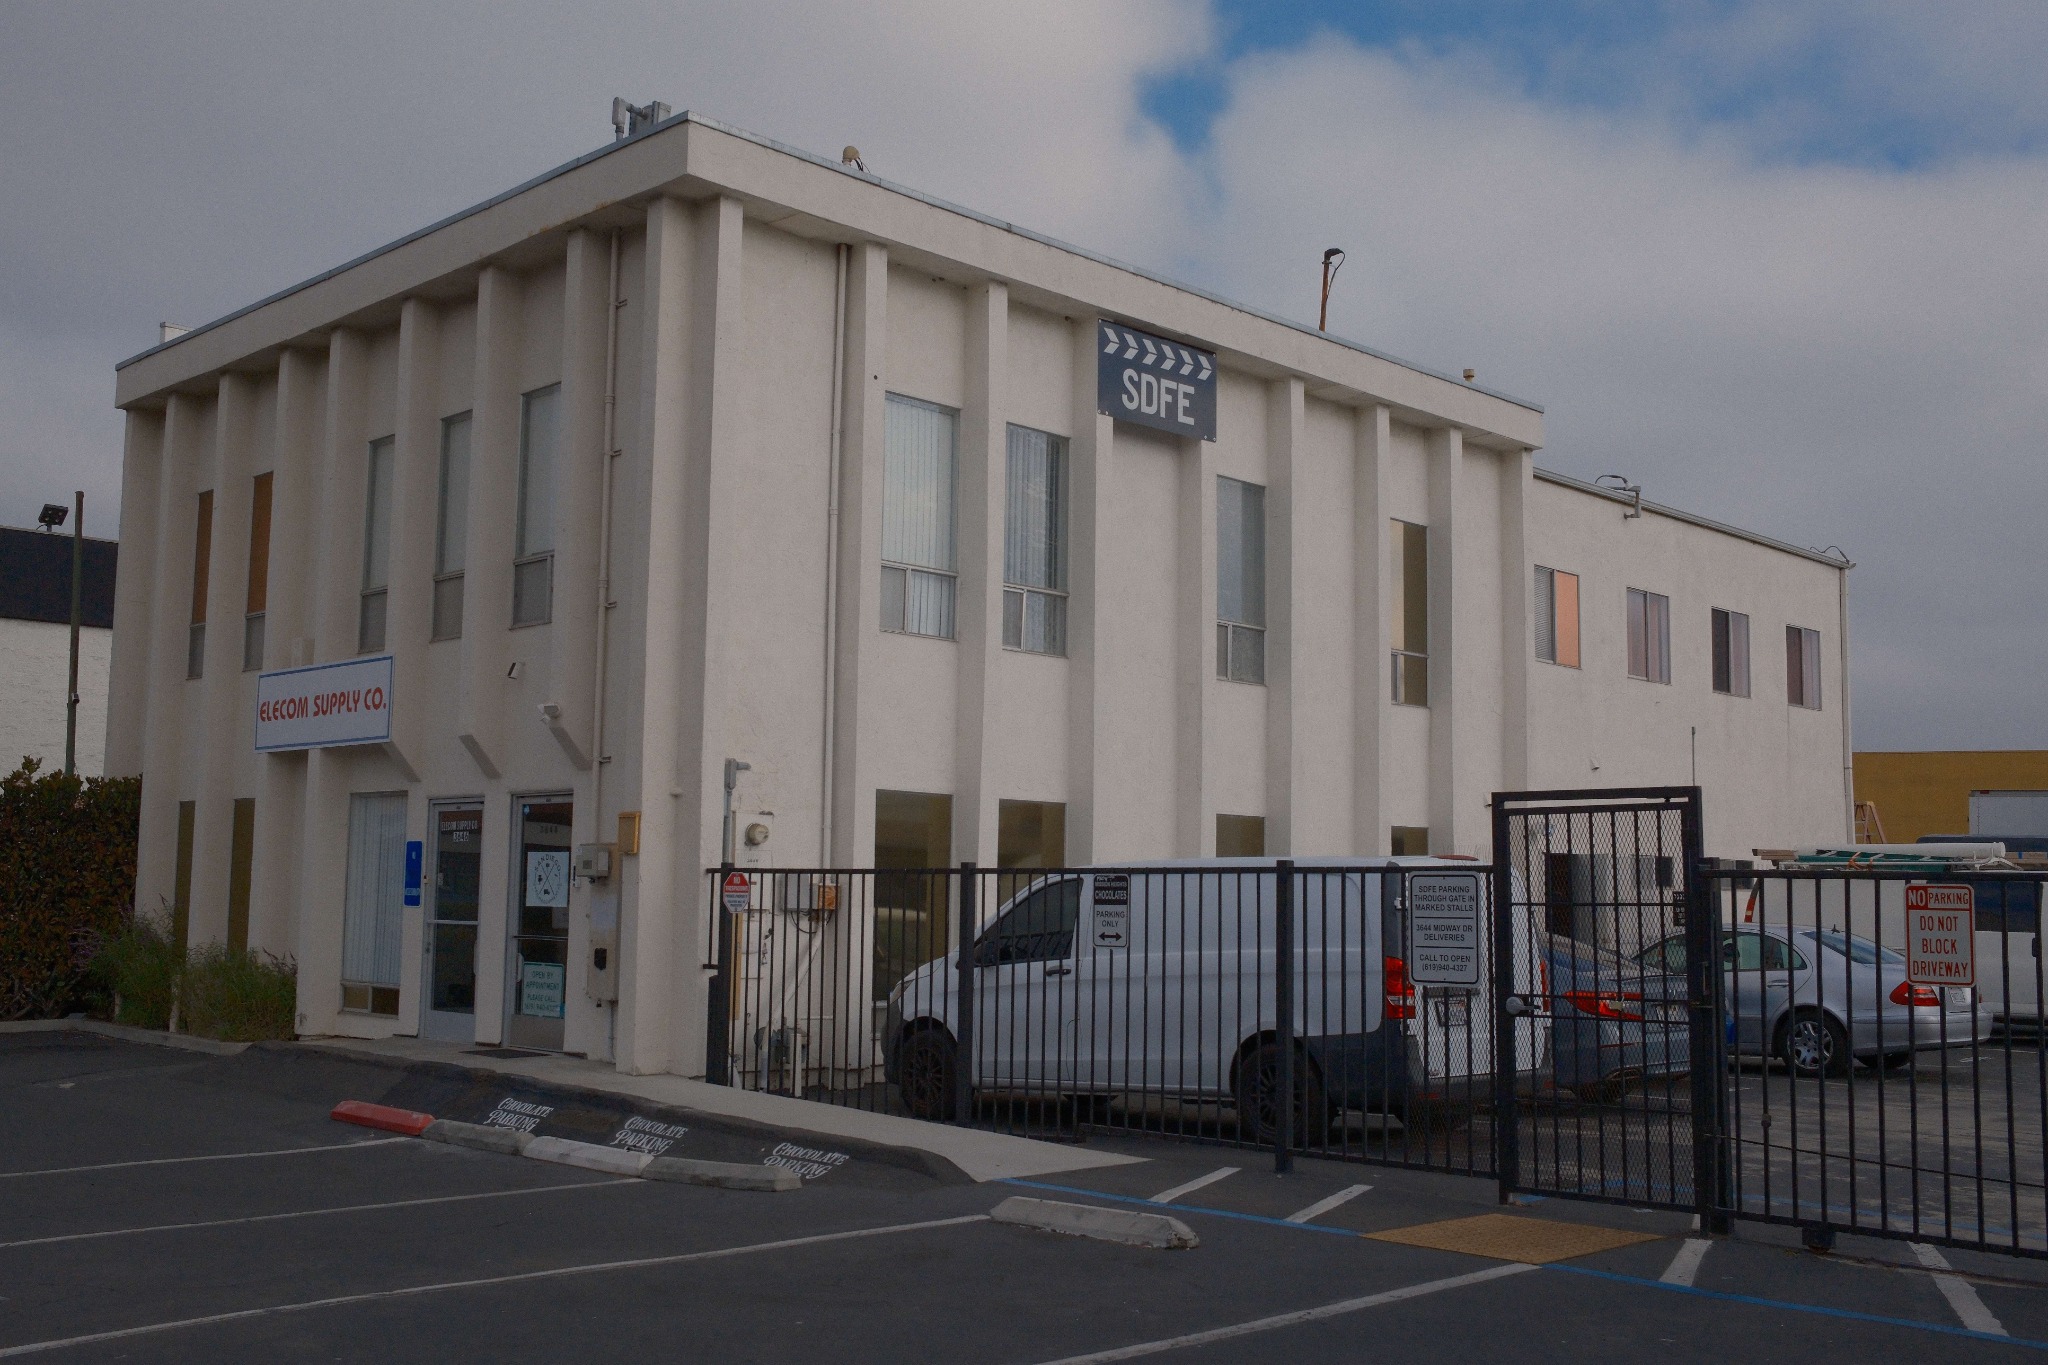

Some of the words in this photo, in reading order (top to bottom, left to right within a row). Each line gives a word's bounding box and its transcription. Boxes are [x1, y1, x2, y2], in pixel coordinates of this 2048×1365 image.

[1121, 368, 1195, 426] SDFE
[259, 695, 309, 722] ELECOM
[313, 690, 360, 716] SUPPLY
[364, 686, 387, 712] CO.
[1094, 890, 1127, 900] CHOCOLATES
[1418, 885, 1437, 893] SDFE
[1438, 885, 1470, 894] PARKING
[1907, 889, 1926, 906] NO
[1928, 892, 1969, 905] PARKING
[1414, 894, 1447, 903] THROUGH
[1448, 894, 1466, 903] GATE
[1467, 895, 1475, 903] IN
[1096, 910, 1125, 918] PARKING
[1415, 903, 1445, 912] MARKED
[1446, 904, 1474, 912] STALLS
[1101, 920, 1119, 928] ONLY
[1416, 924, 1432, 932] 3644
[1433, 924, 1461, 932] MIDWAY
[1462, 924, 1473, 932] DR
[1919, 915, 1934, 932] DO
[1937, 916, 1958, 932] NOT
[1424, 933, 1465, 941] DELIVERIES
[1921, 938, 1958, 955] BLOCK
[1419, 954, 1438, 962] CALL
[1439, 954, 1450, 962] TO
[1451, 954, 1471, 963] OPEN
[1912, 960, 1969, 978] DRIVEWAY
[497, 1097, 555, 1118] CHOCOLATE
[482, 1109, 541, 1133] PARKING
[624, 1115, 689, 1139] CHOCOLATE
[609, 1129, 674, 1155] PARKING
[772, 1142, 850, 1166] CHOCOLATE
[763, 1155, 833, 1179] PARKING
